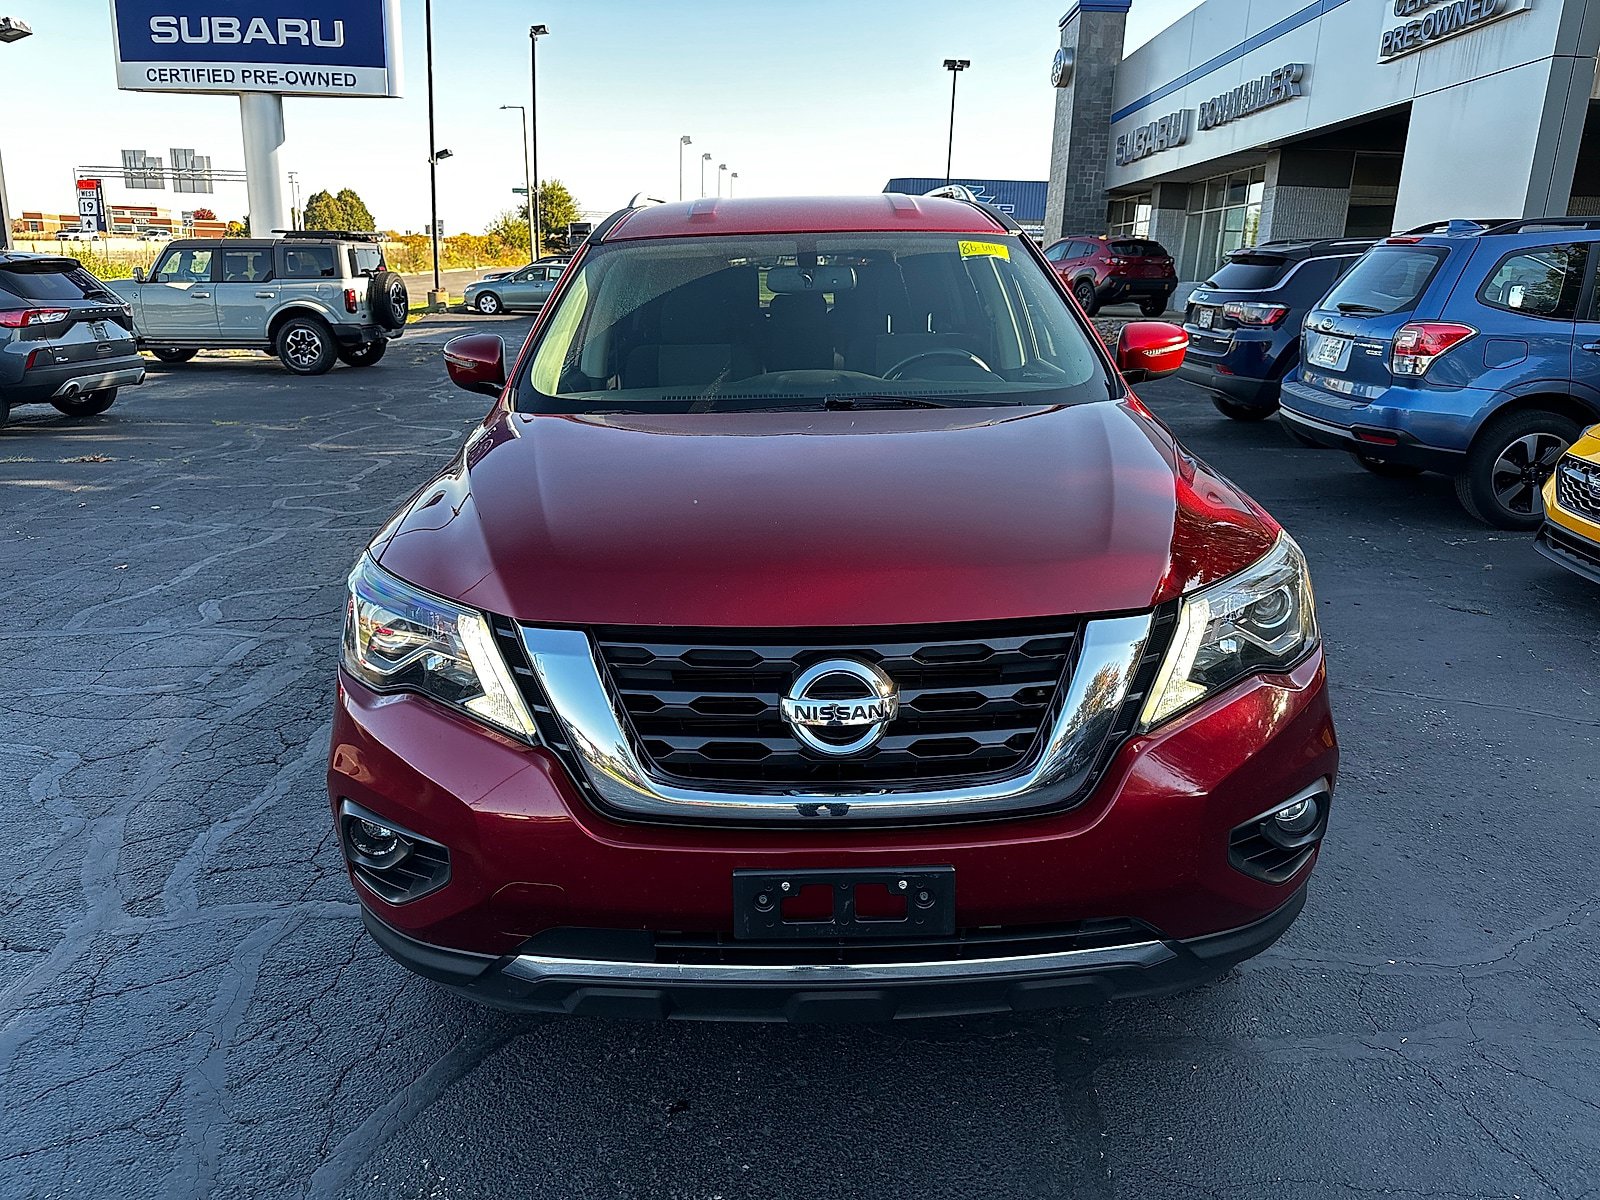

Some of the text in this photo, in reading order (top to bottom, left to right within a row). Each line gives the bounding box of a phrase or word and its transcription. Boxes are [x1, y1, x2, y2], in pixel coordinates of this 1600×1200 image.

[150, 16, 345, 48] SUBARU
[1380, 0, 1499, 56] PRE-OWNED
[146, 68, 357, 87] CERTIFIED PRE-OWNED
[1115, 109, 1191, 166] SUBARU
[82, 201, 94, 212] 19
[183, 219, 193, 227] 55
[794, 703, 884, 721] NISSAN
